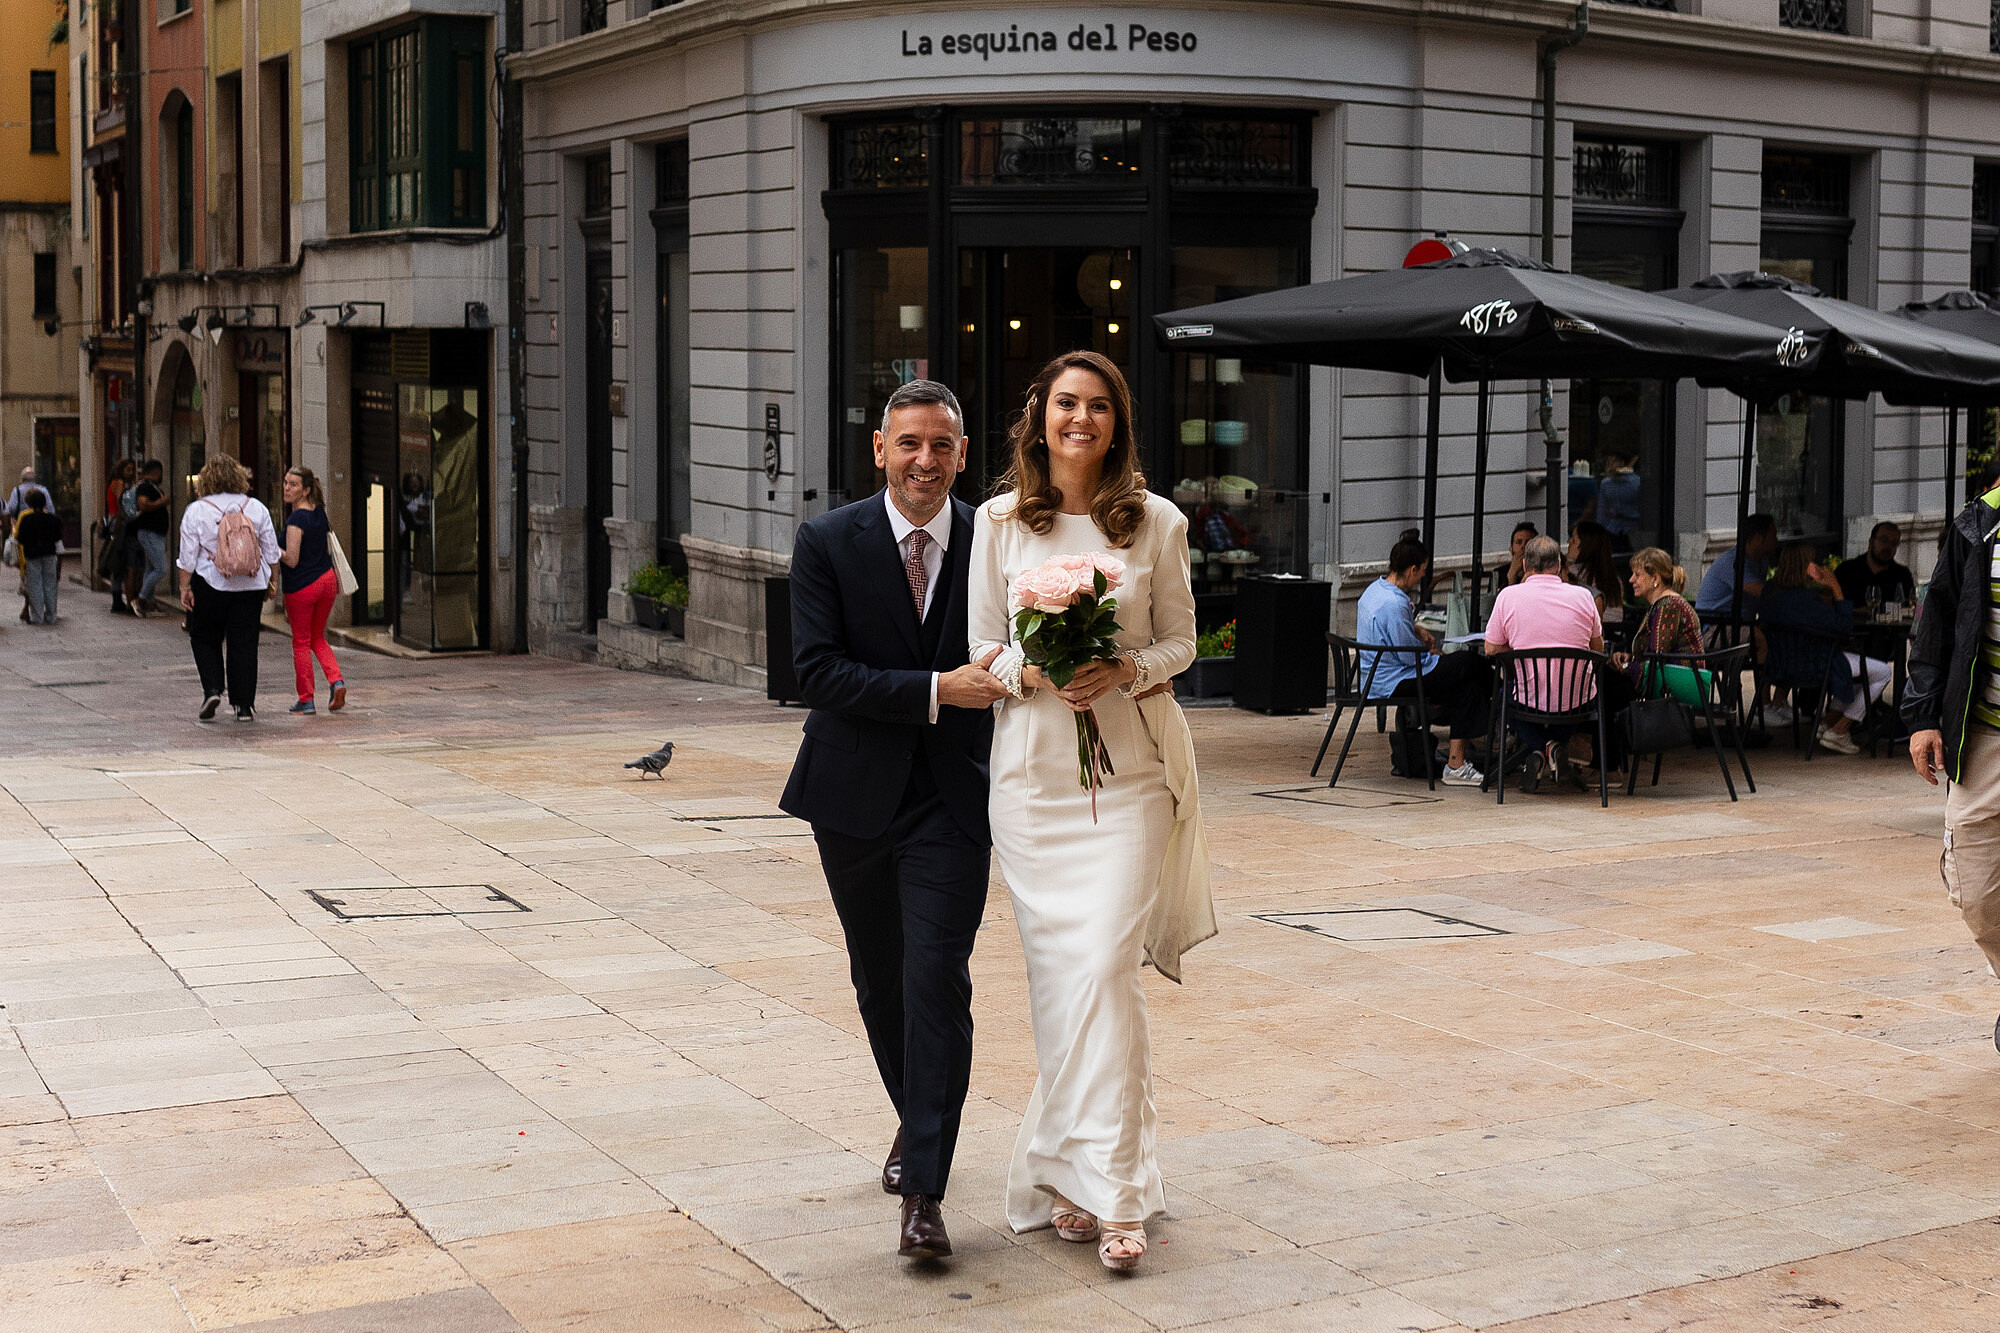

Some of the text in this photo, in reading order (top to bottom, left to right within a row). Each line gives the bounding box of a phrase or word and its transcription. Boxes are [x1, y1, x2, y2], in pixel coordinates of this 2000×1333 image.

[902, 23, 1198, 61] La esquina del Peso
